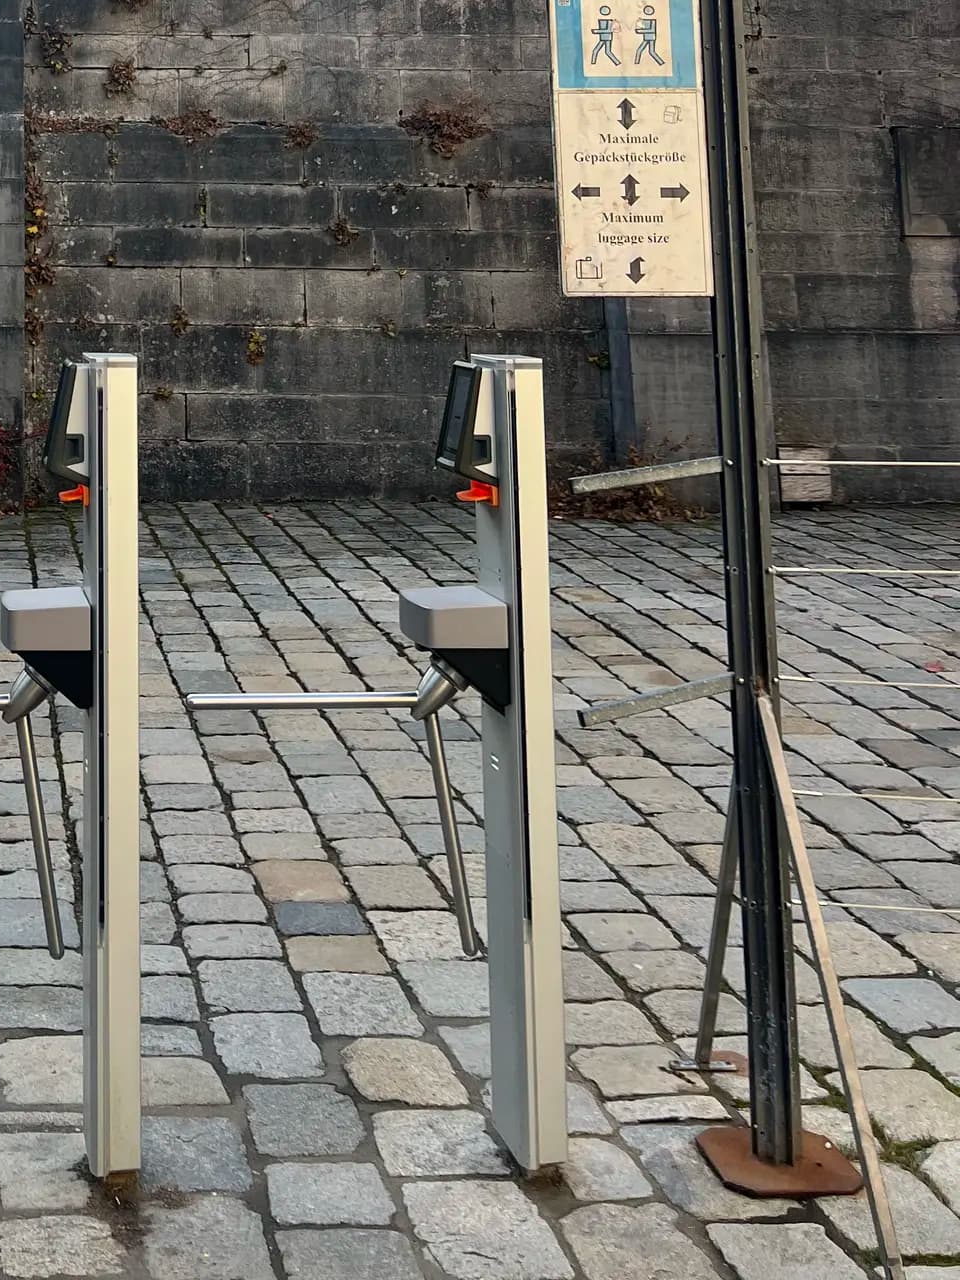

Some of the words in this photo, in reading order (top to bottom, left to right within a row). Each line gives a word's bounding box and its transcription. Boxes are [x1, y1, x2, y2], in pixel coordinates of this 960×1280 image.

[599, 133, 659, 144] Maximale
[574, 151, 686, 164] Gepäckstückgröße
[601, 213, 664, 223] Maximum
[598, 233, 644, 245] luggage
[648, 233, 669, 243] size
